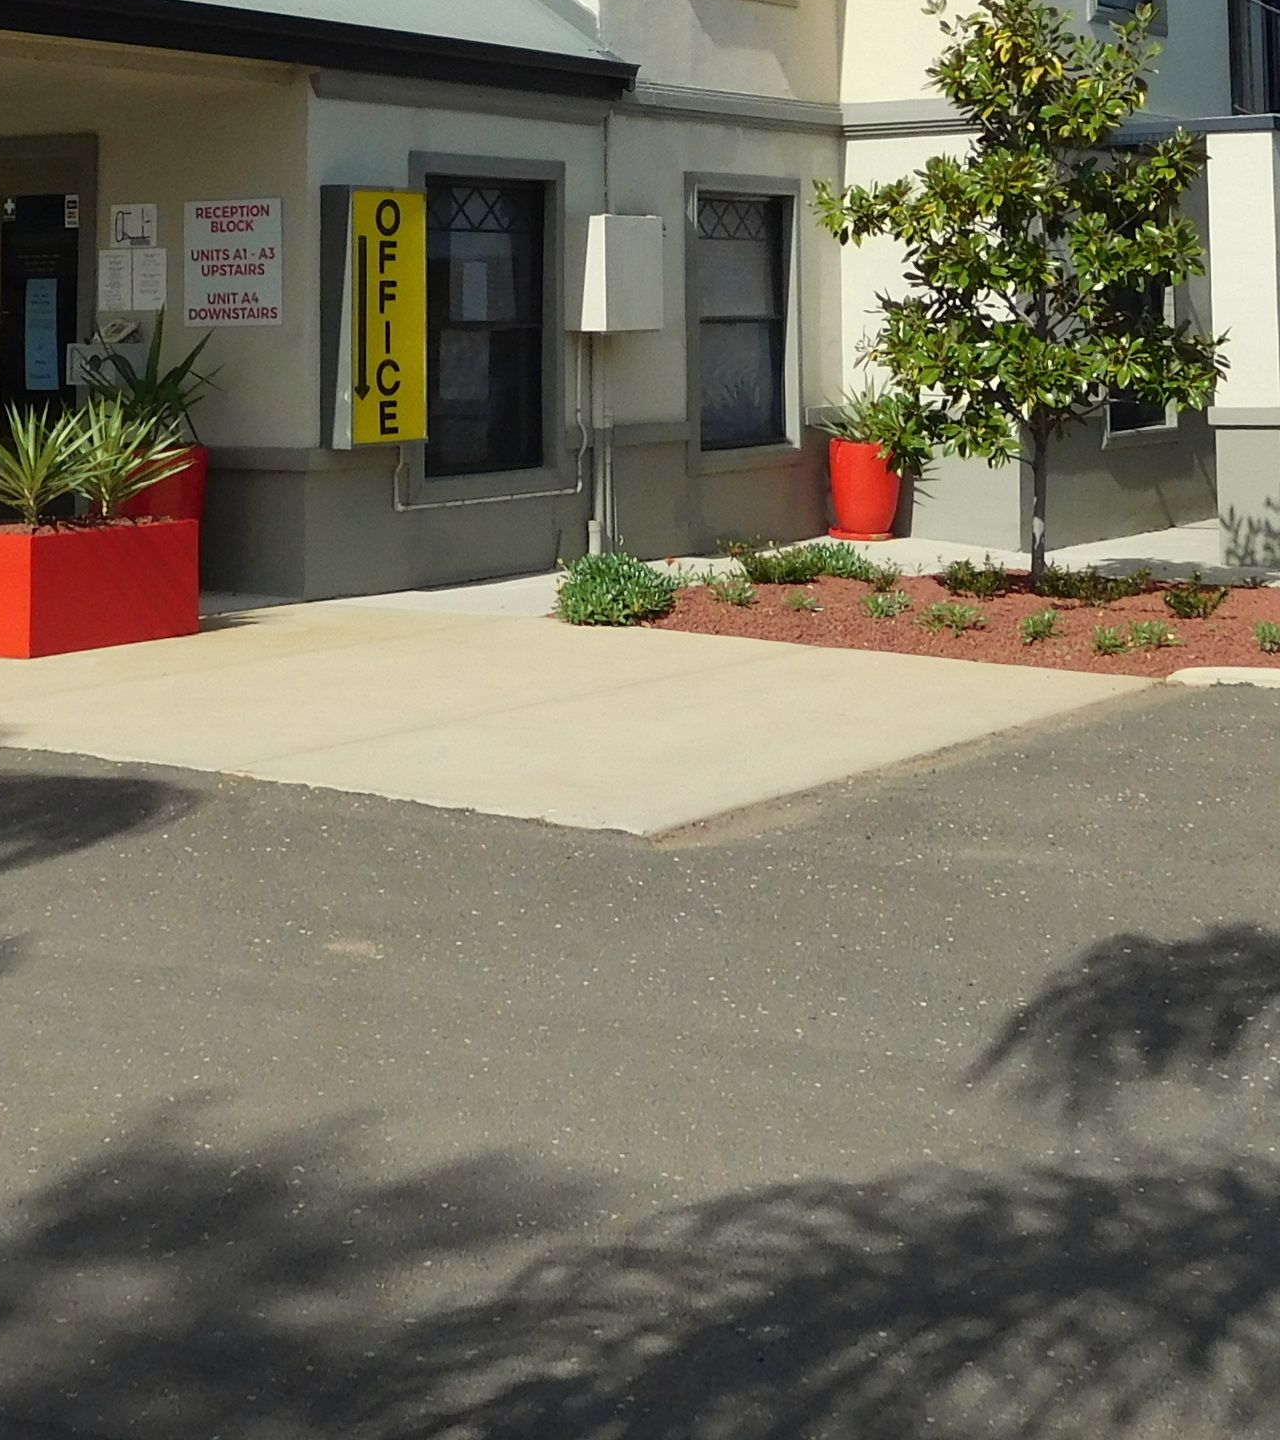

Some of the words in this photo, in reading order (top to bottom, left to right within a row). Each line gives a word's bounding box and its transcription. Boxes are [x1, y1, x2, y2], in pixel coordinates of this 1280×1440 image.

[195, 204, 270, 219] RECEPTION
[210, 220, 254, 233] BLOCK
[191, 248, 230, 261] UNITS
[233, 248, 247, 260] A1
[258, 247, 276, 260] A3
[201, 263, 265, 277] UPSTAIRS
[207, 292, 239, 305] UNIT
[241, 292, 259, 304] A4
[188, 307, 278, 320] DOWNSTAIRS
[375, 198, 401, 436] OFFICE
